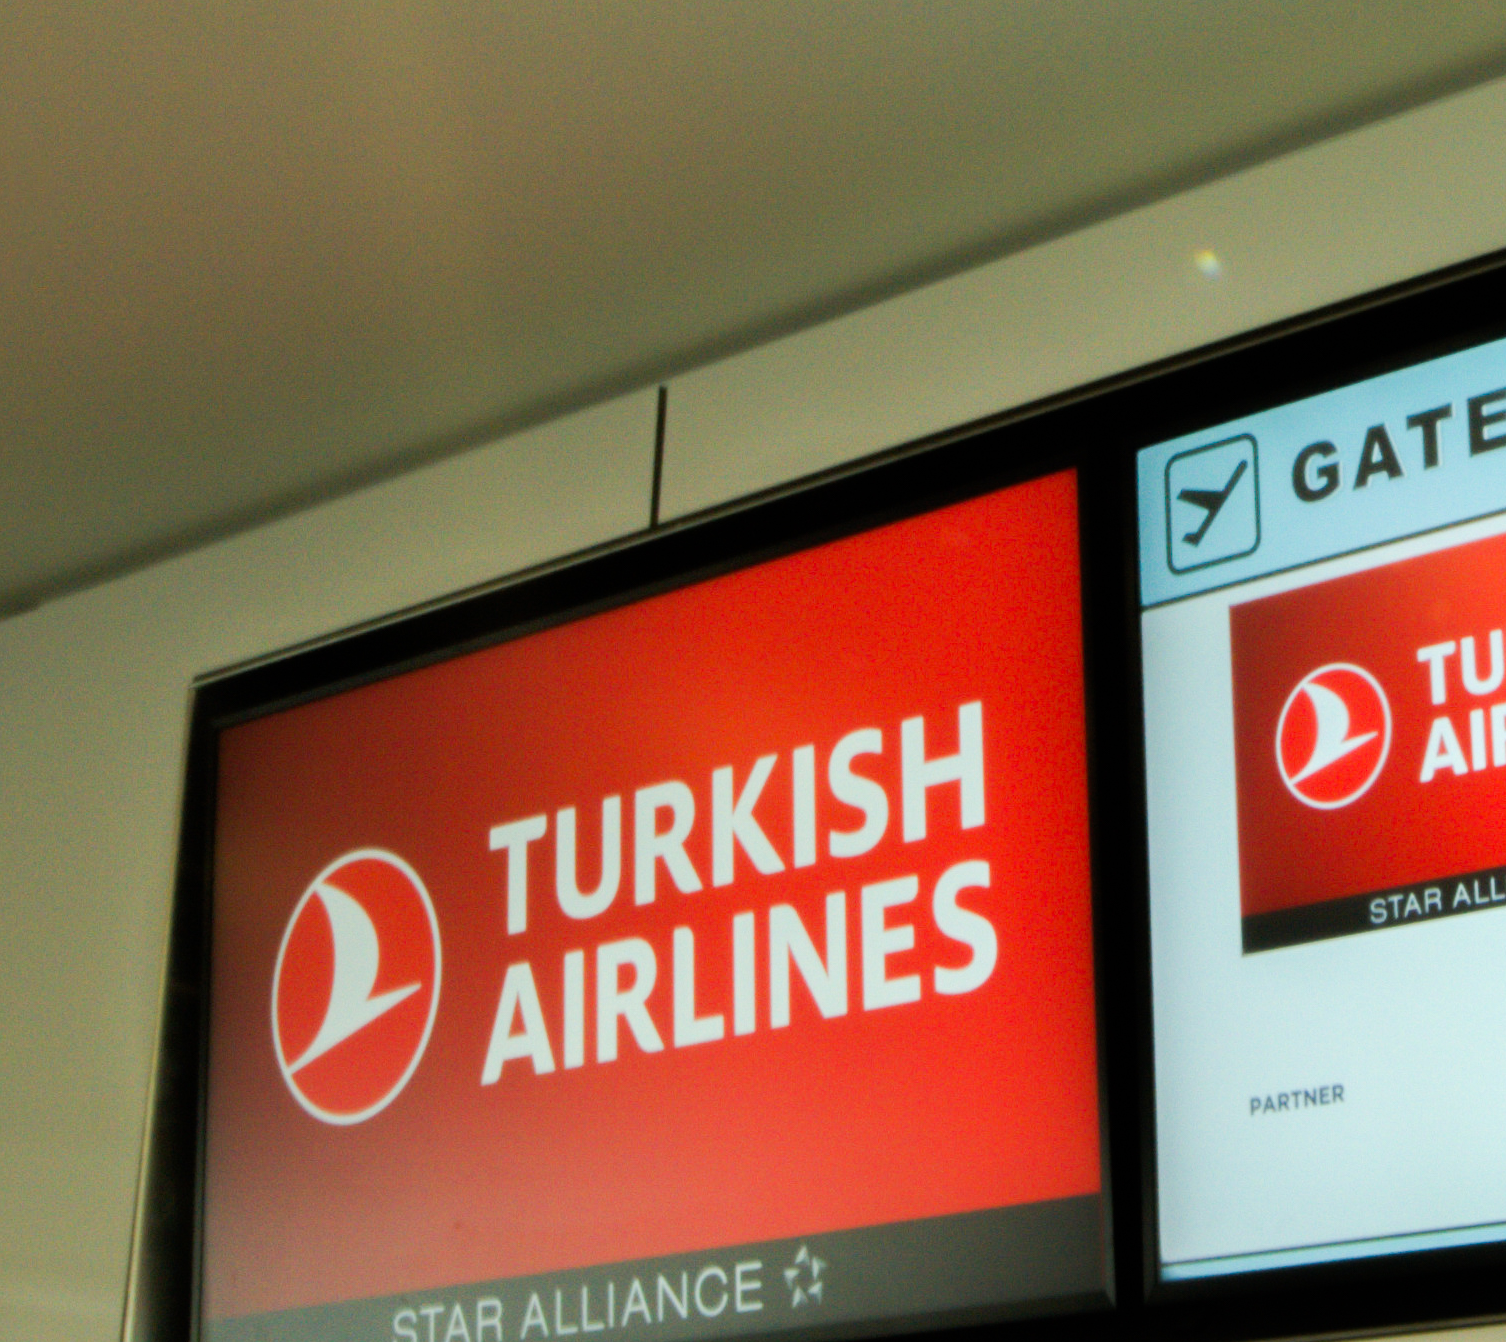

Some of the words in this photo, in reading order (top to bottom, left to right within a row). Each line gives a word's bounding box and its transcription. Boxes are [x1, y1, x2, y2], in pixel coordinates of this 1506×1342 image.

[490, 701, 985, 934] TURKISH
[1371, 888, 1441, 922] STAR
[481, 860, 998, 1085] AIRLINES
[1250, 1084, 1344, 1115] PARTNER
[521, 1261, 763, 1339] ALLIANCE
